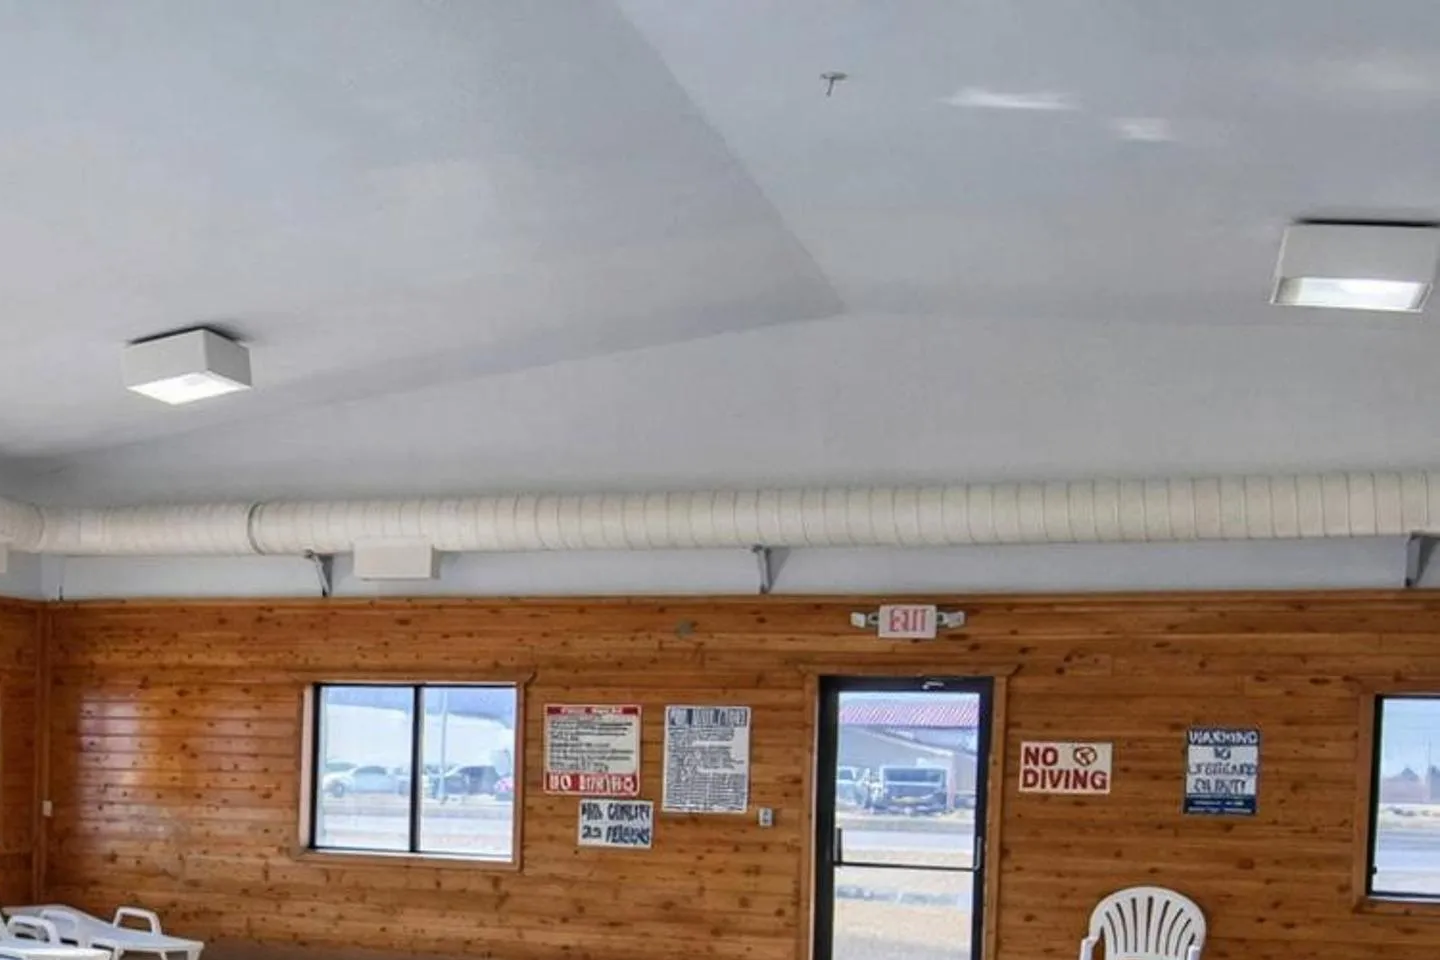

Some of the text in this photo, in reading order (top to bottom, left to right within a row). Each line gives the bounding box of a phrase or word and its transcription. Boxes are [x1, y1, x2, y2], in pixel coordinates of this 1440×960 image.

[888, 608, 927, 632] EXIT
[1023, 746, 1059, 767] NO
[1021, 768, 1108, 790] DIVING
